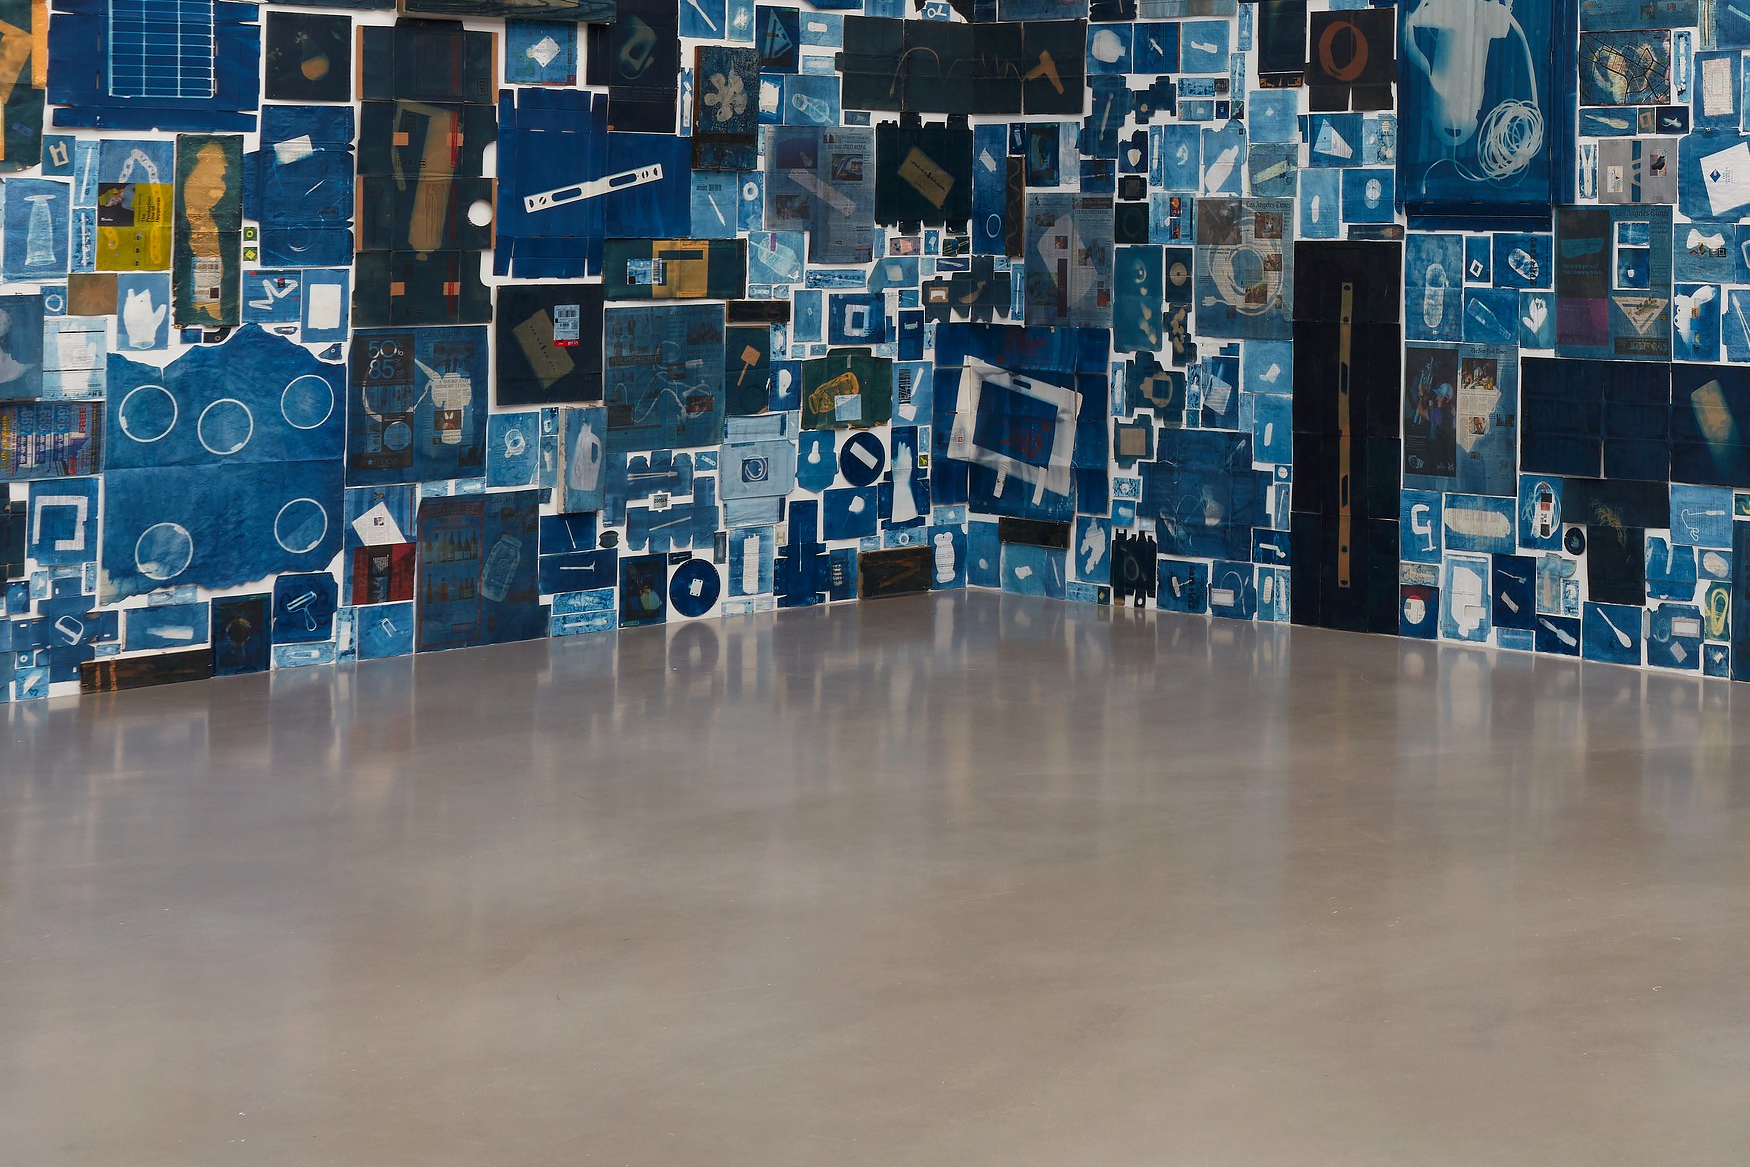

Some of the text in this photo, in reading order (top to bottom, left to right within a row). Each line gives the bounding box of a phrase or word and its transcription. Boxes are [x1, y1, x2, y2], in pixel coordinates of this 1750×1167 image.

[1256, 200, 1275, 209] Angeles
[1275, 200, 1292, 208] Times
[78, 407, 87, 434] FREE
